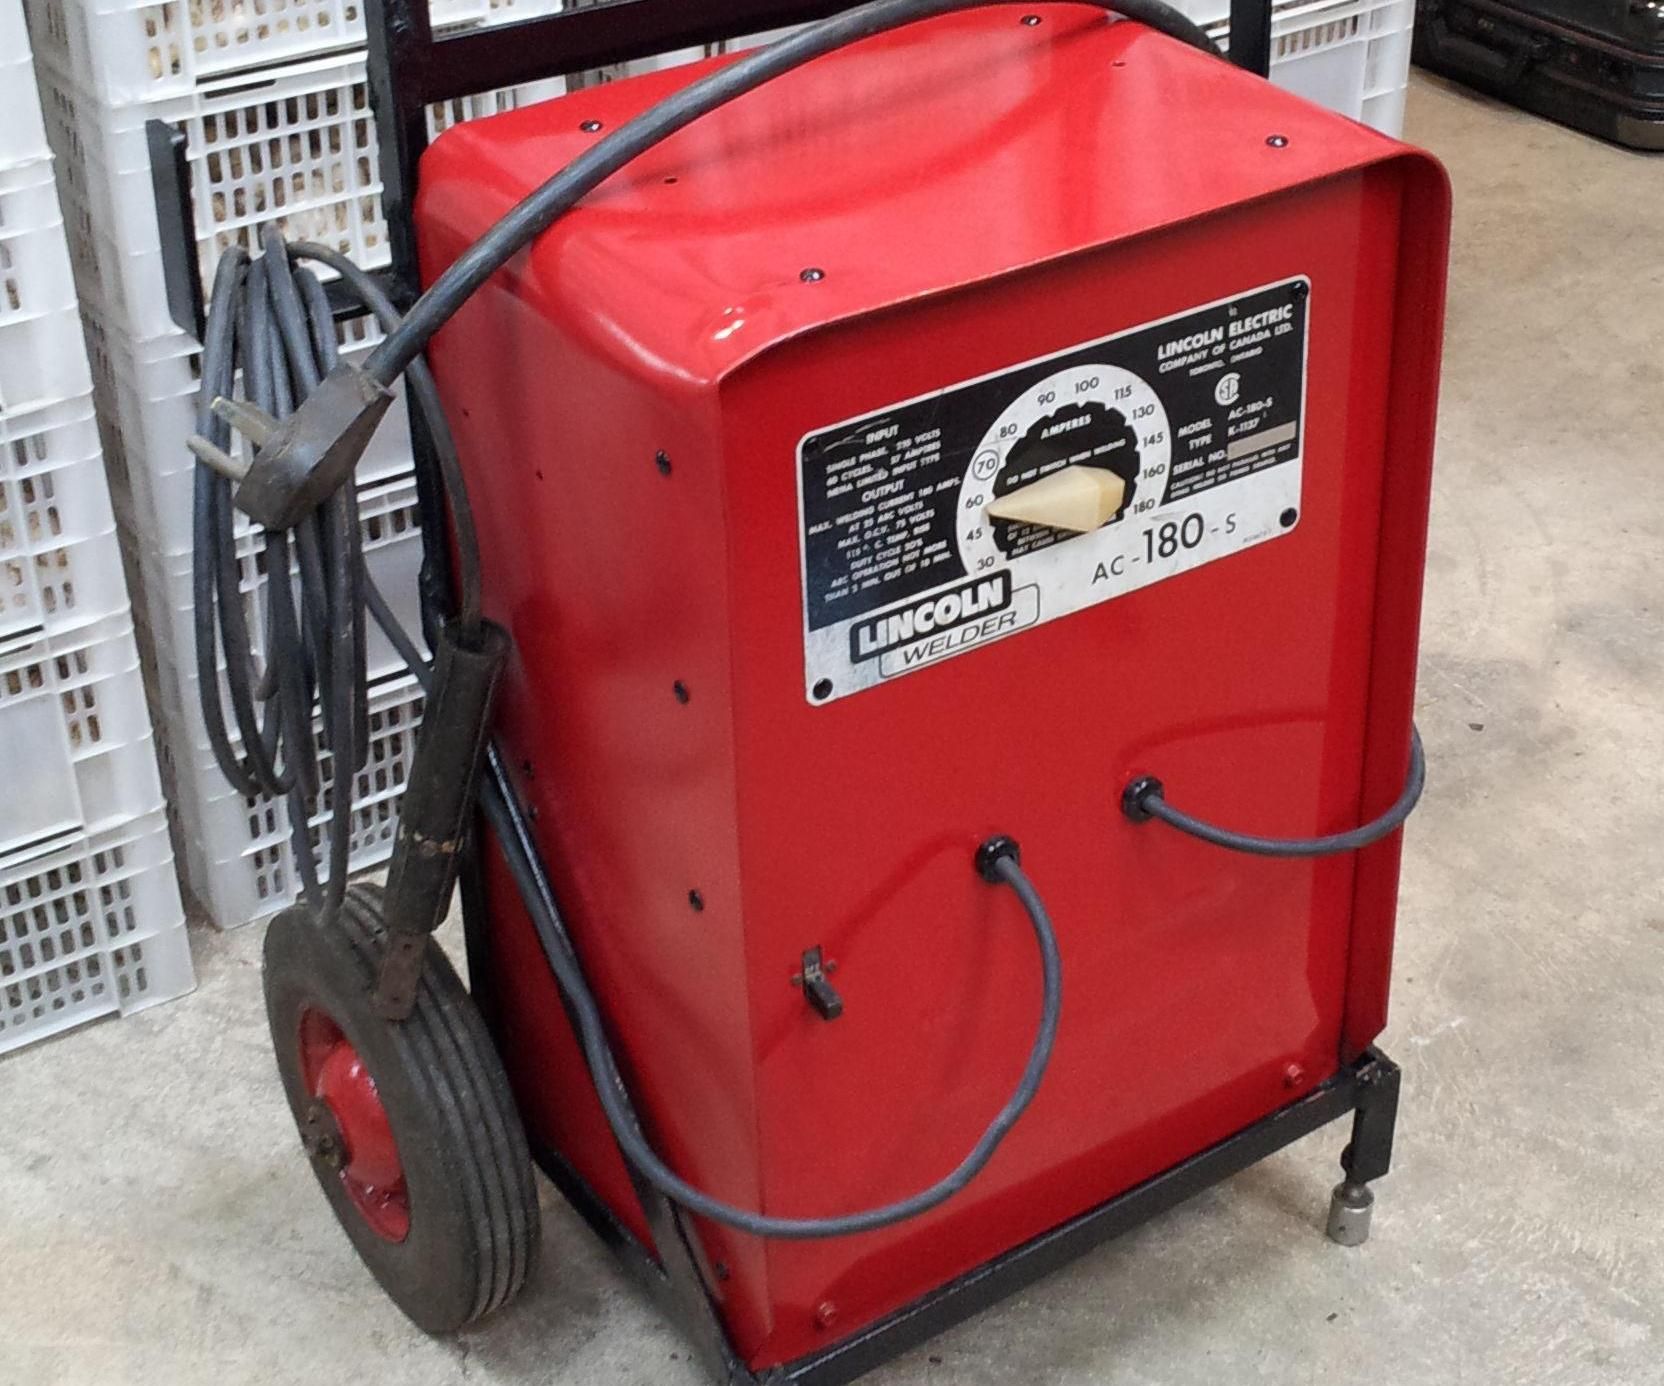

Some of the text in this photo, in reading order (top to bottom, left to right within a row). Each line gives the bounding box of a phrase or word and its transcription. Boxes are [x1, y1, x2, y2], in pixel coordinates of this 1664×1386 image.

[1157, 303, 1293, 361] LINCOLN ELECTRIC
[1159, 350, 1209, 374] COMPANY
[1212, 344, 1226, 356] OF
[1230, 330, 1271, 351] CANADA
[1074, 376, 1099, 394] 100
[1114, 384, 1132, 400] 115
[1037, 391, 1055, 406] 90
[1132, 403, 1155, 420] 130
[1178, 397, 1273, 438] MODEL AC-180-S
[866, 425, 900, 445] INPUT
[999, 423, 1017, 438] 80
[1040, 413, 1092, 440] AMPERES
[915, 429, 942, 444] VOLTS
[1142, 431, 1164, 448] 145
[1189, 434, 1213, 451] TYPE
[905, 441, 942, 460] AMPERES
[977, 458, 996, 474] 70
[1143, 464, 1165, 480] 160
[1173, 458, 1205, 476] SERIAL
[1208, 450, 1228, 464] NO.
[862, 479, 905, 503] OUTPUT
[965, 494, 984, 509] 60
[1133, 498, 1156, 515] 180
[809, 521, 833, 536] MAX.
[836, 505, 875, 526] WELDING
[878, 492, 915, 512] CURRENT
[849, 522, 861, 534] AT
[878, 511, 896, 524] ARC
[898, 501, 925, 516] VOLTS
[838, 535, 861, 550] MAX.
[909, 509, 936, 525] VOLTS
[966, 528, 983, 542] 45
[831, 575, 849, 589] ARC
[903, 552, 921, 564] NOT
[976, 556, 995, 571] 30
[858, 575, 1003, 656] LINCOLN
[903, 610, 1017, 675] WELDER
